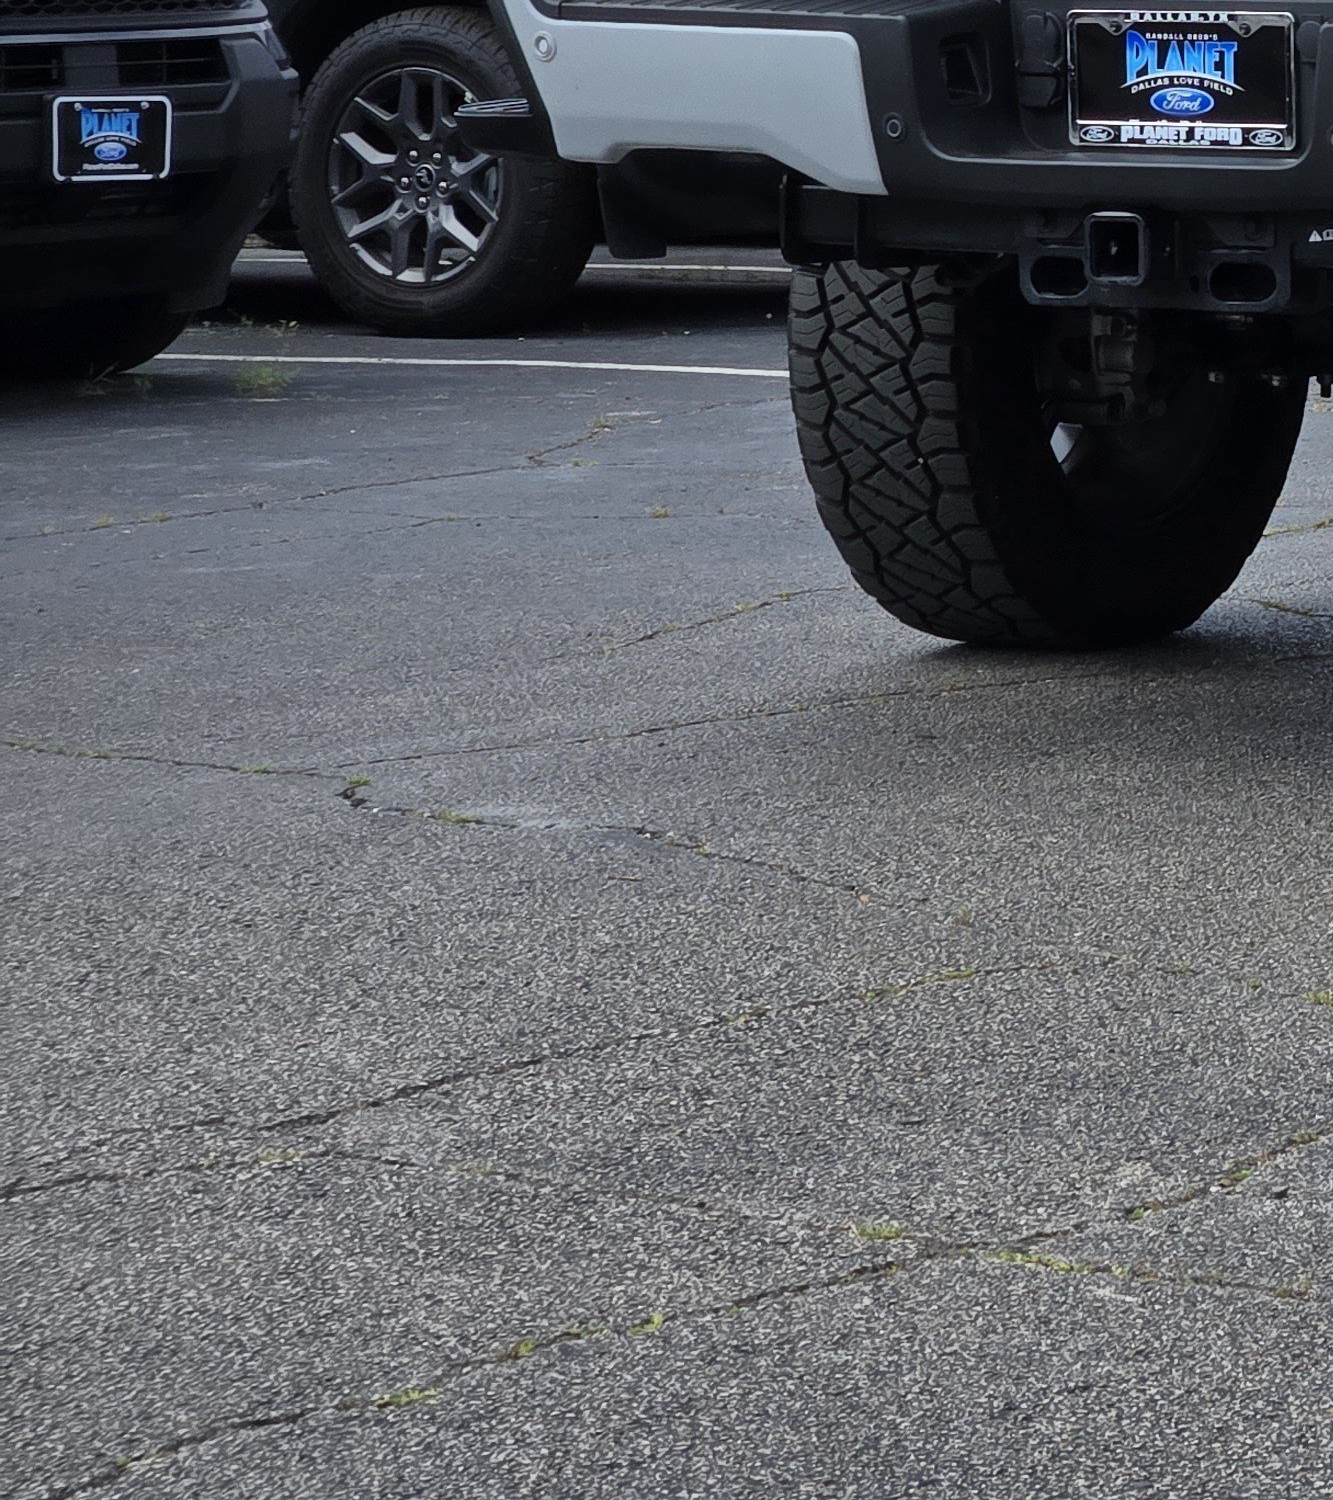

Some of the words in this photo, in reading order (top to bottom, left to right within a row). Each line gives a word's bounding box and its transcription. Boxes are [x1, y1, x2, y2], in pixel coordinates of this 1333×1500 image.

[1126, 29, 1238, 84] PLANET
[1131, 78, 1170, 94] DALLAS
[1173, 77, 1200, 87] LOVE
[1203, 79, 1234, 96] FIELD
[1162, 91, 1202, 111] Ford
[81, 107, 140, 140] PLANET
[1120, 126, 1189, 142] PLANET
[1194, 128, 1243, 145] FORD
